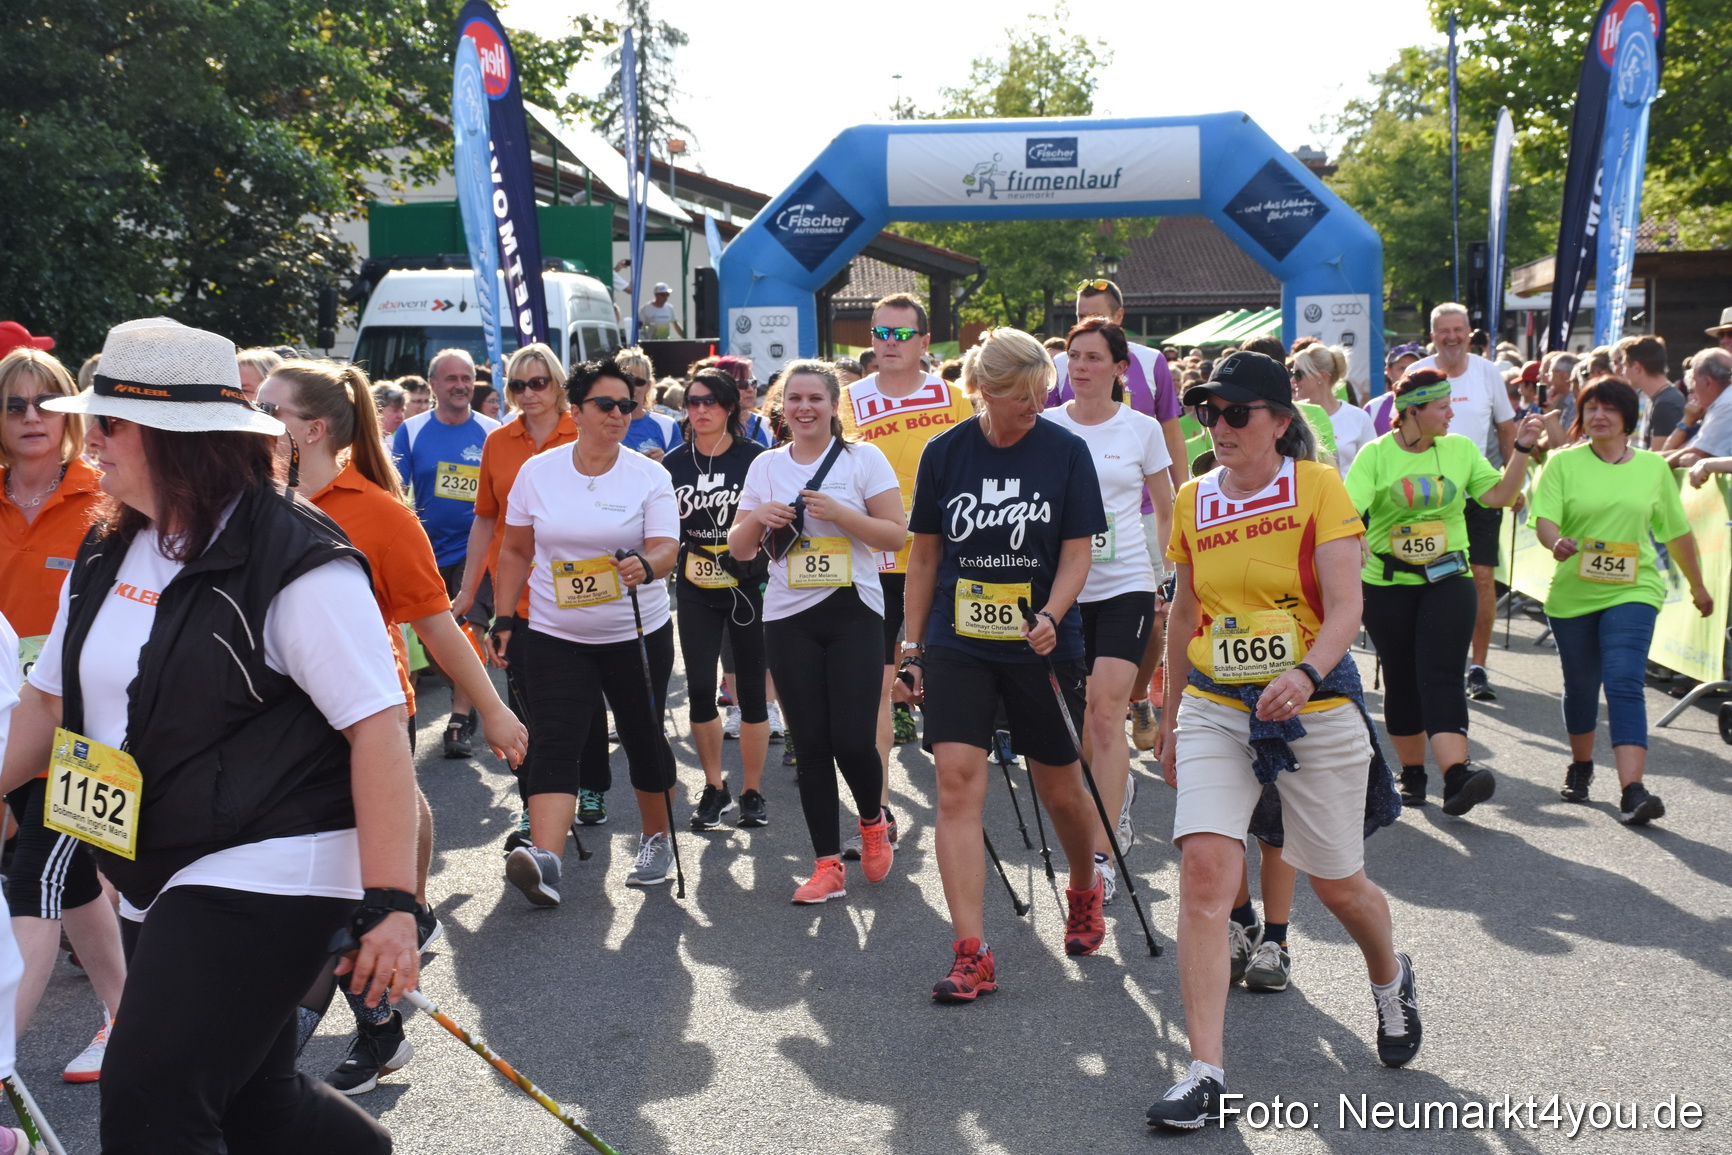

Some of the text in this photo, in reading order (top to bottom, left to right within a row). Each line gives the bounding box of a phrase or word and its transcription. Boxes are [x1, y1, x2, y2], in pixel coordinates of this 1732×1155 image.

[1037, 148, 1076, 158] Fischer
[1007, 167, 1123, 191] firmenlauf
[1007, 191, 1055, 200] neumarkt
[1244, 203, 1262, 214] und
[1263, 200, 1281, 210] das
[788, 214, 849, 227] Fischer
[378, 300, 427, 311] abavent
[127, 386, 172, 397] KLEBL
[858, 412, 956, 442] MAX BÖGL
[441, 475, 478, 491] 2320
[947, 492, 1050, 551] Burgis
[1196, 515, 1302, 552] MAX BÖGL
[1402, 537, 1435, 553] 456
[805, 555, 830, 573] 85
[959, 554, 1041, 568] Knödelliebe.
[1591, 555, 1626, 572] 454
[571, 576, 598, 594] 92
[970, 602, 1013, 625] 386
[965, 621, 990, 630] Dietmayr
[1218, 635, 1286, 664] 1666
[1214, 660, 1296, 672] Schäfer-Dunning Martina
[60, 770, 126, 826] 1152
[87, 816, 107, 831] Ingrid
[108, 824, 128, 839] Maria
